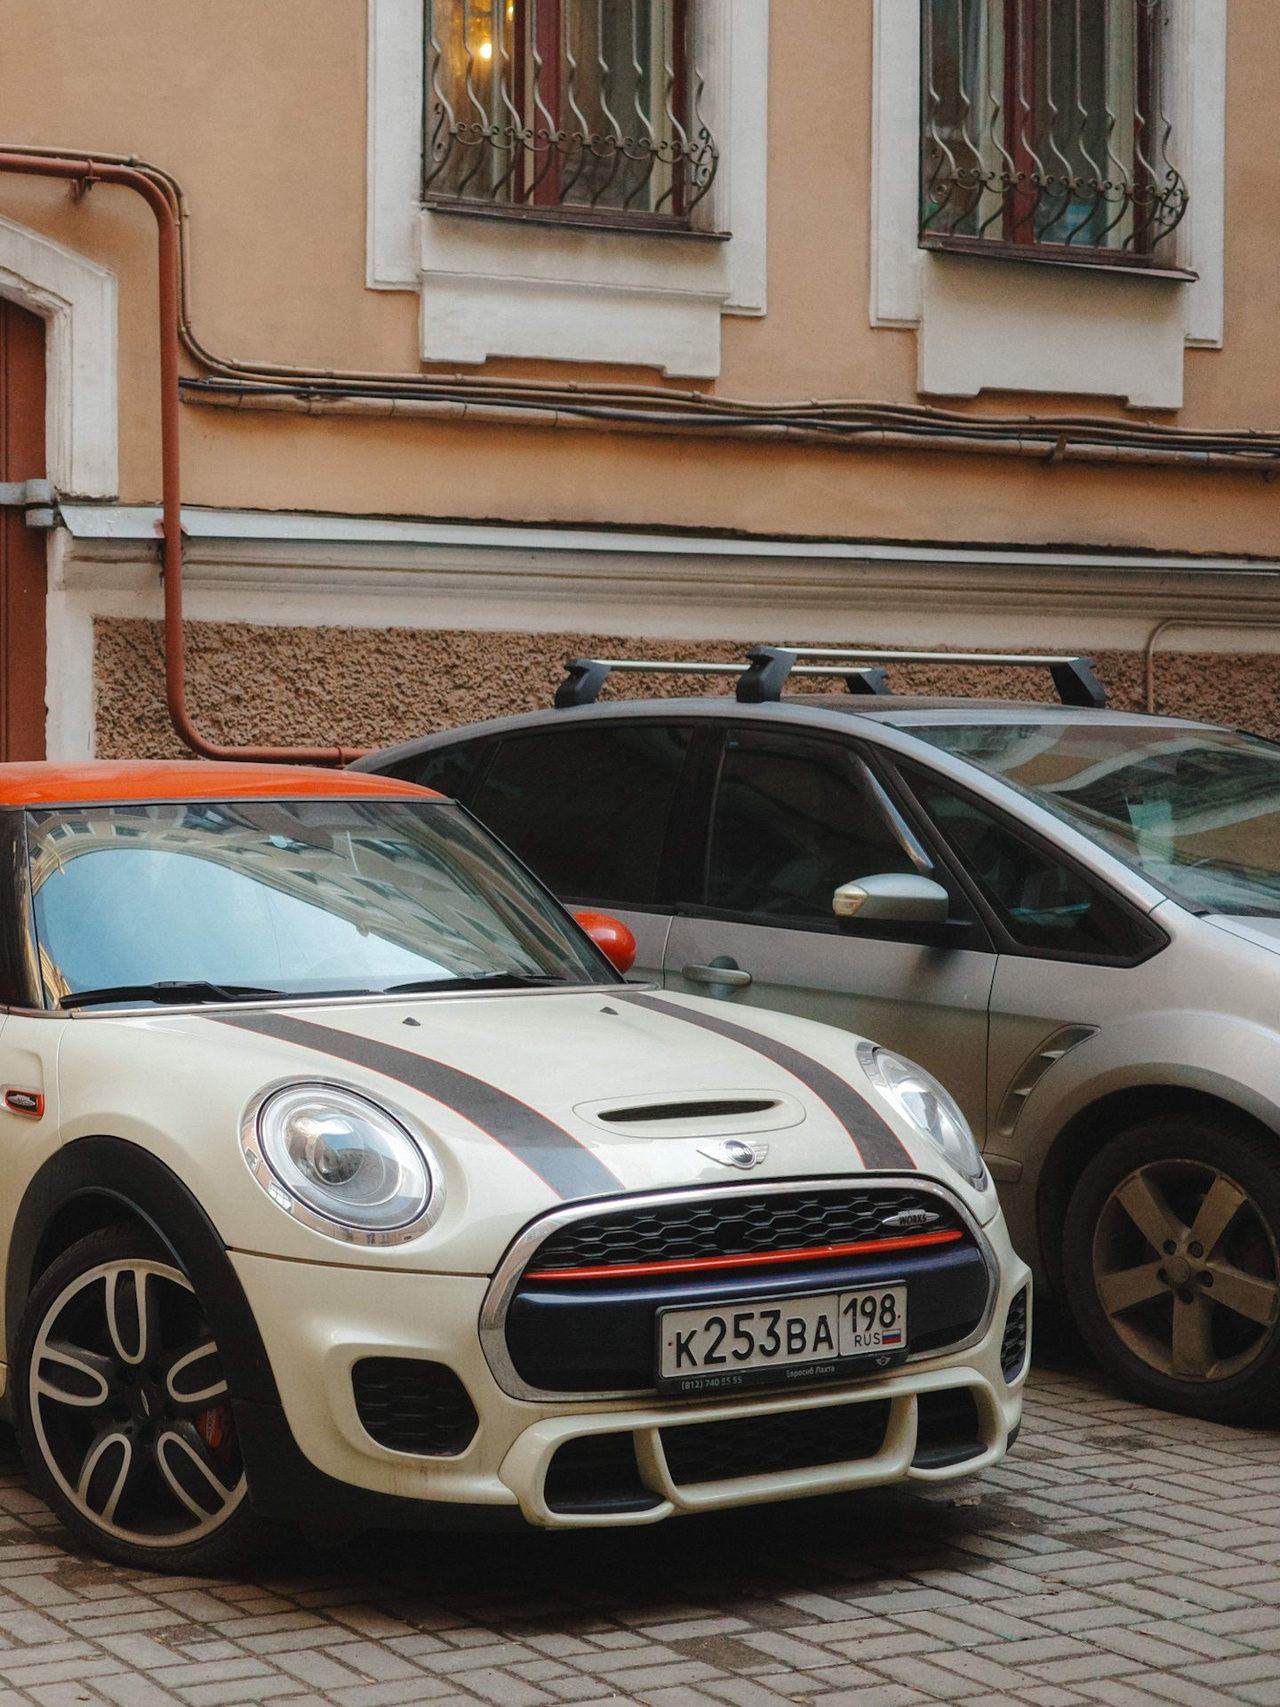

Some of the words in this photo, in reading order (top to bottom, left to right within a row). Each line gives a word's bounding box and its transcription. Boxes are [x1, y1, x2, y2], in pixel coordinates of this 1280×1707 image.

[899, 1214, 926, 1225] WORKS
[843, 1293, 896, 1333] 198
[854, 1333, 880, 1347] RUS
[681, 1380, 703, 1390] (812)
[705, 1378, 720, 1387] 740
[721, 1377, 731, 1386] 55
[733, 1376, 742, 1384] 55
